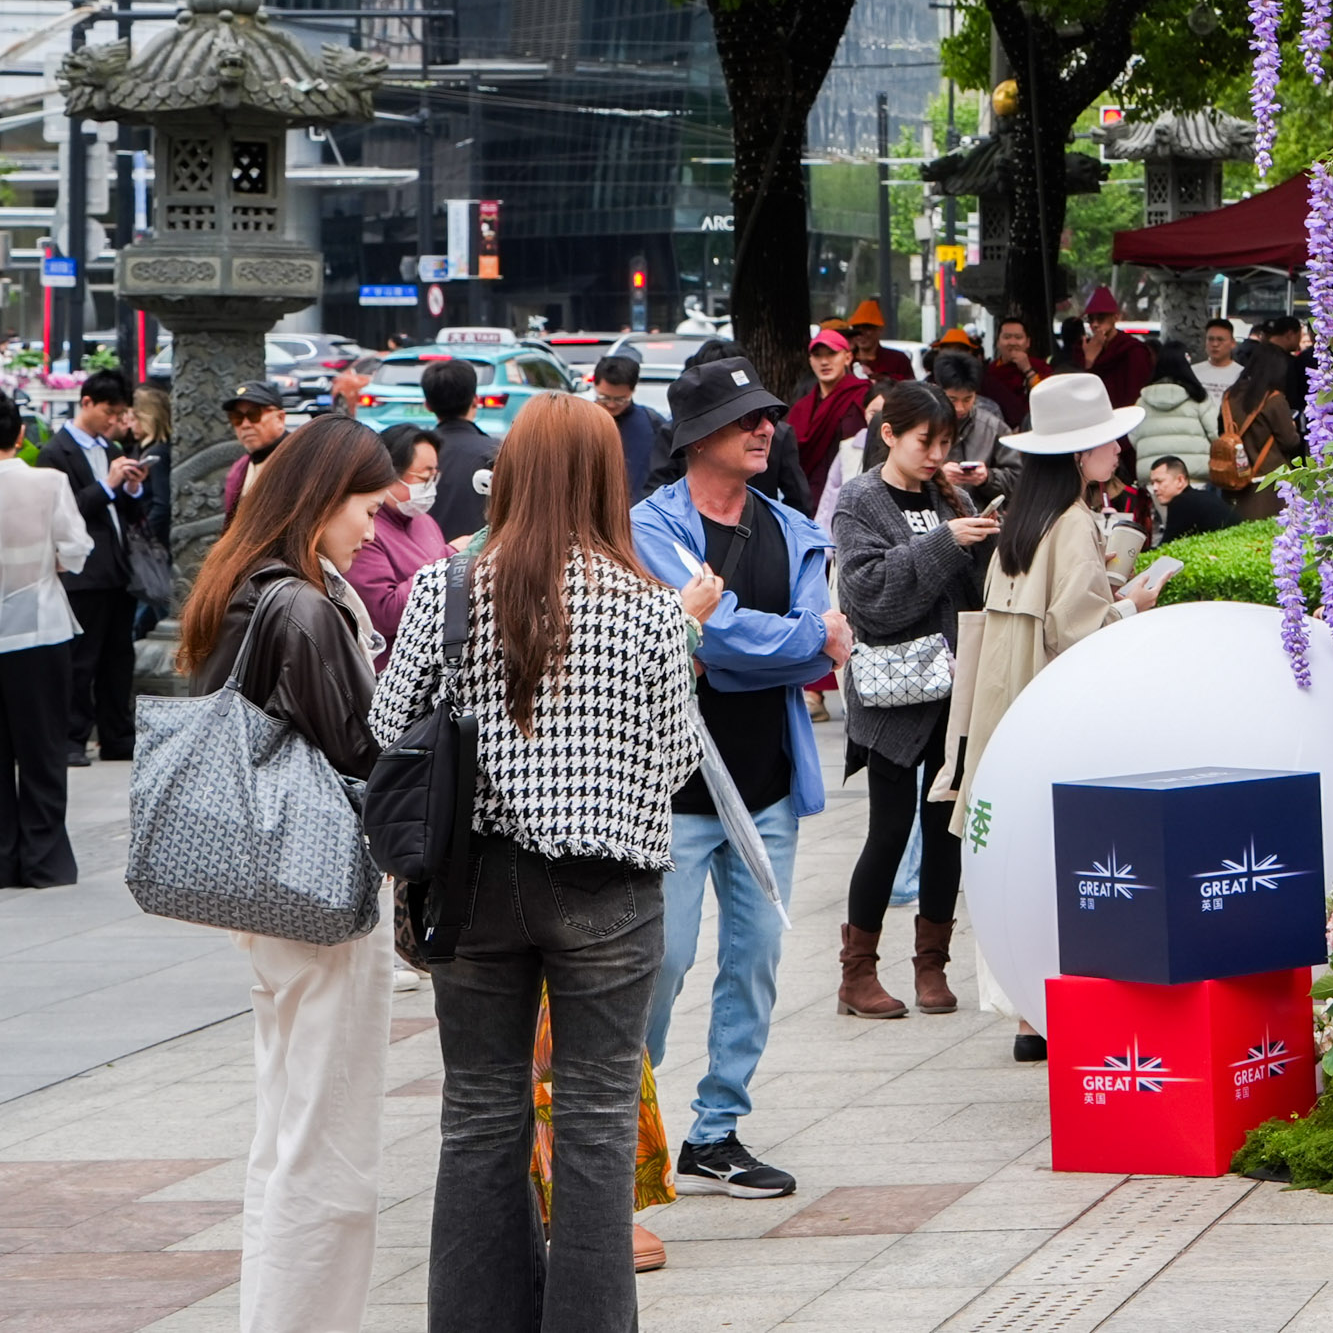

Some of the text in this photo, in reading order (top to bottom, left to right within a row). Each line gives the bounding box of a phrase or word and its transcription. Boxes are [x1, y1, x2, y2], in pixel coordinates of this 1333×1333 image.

[1078, 880, 1112, 898] GREAT
[1200, 877, 1248, 898] GREAT
[1079, 897, 1095, 911] 英国
[1201, 898, 1223, 913] 英国
[1083, 1075, 1132, 1092] GREAT
[1234, 1064, 1265, 1087] GREAT
[1083, 1092, 1106, 1106] 英国
[1234, 1086, 1250, 1101] 英国
